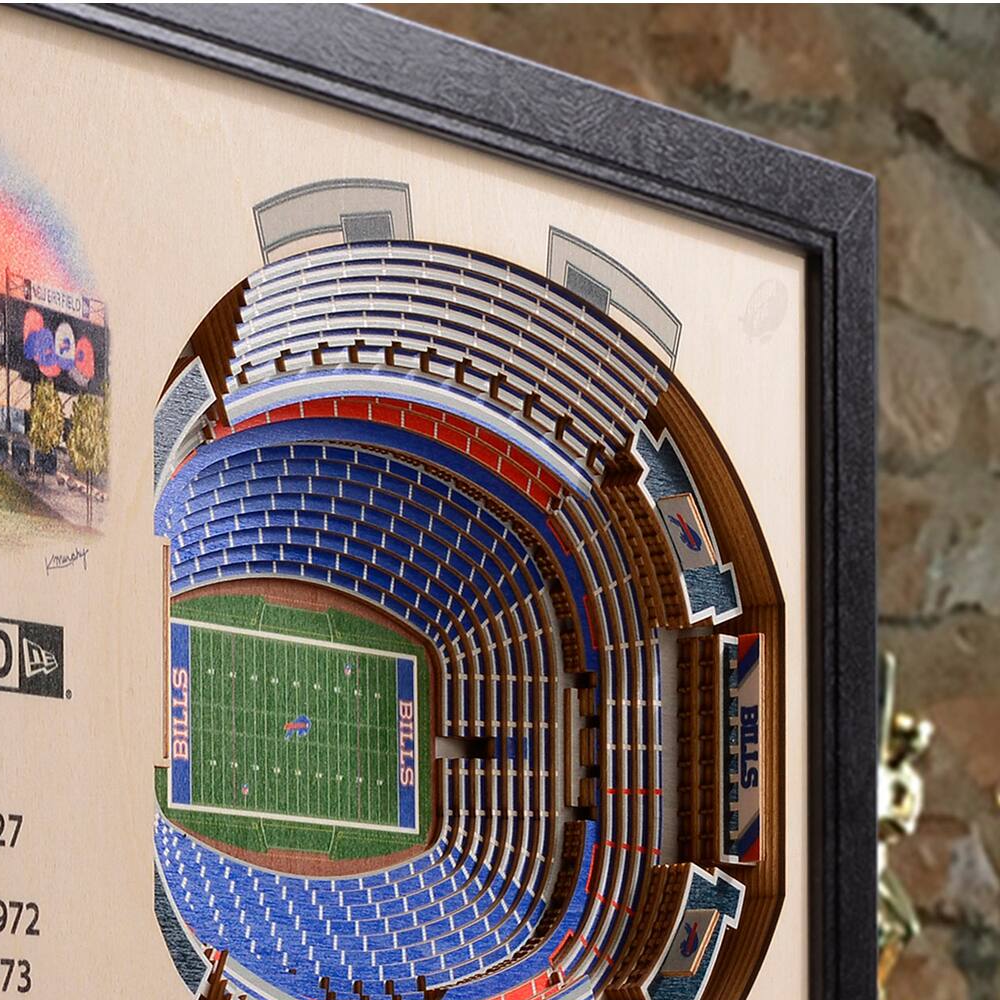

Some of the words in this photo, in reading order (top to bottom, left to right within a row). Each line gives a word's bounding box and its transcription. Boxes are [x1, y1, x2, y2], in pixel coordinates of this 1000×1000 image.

[172, 667, 188, 760] BILLS
[399, 699, 414, 787] BILLS
[740, 704, 759, 789] BILLS
